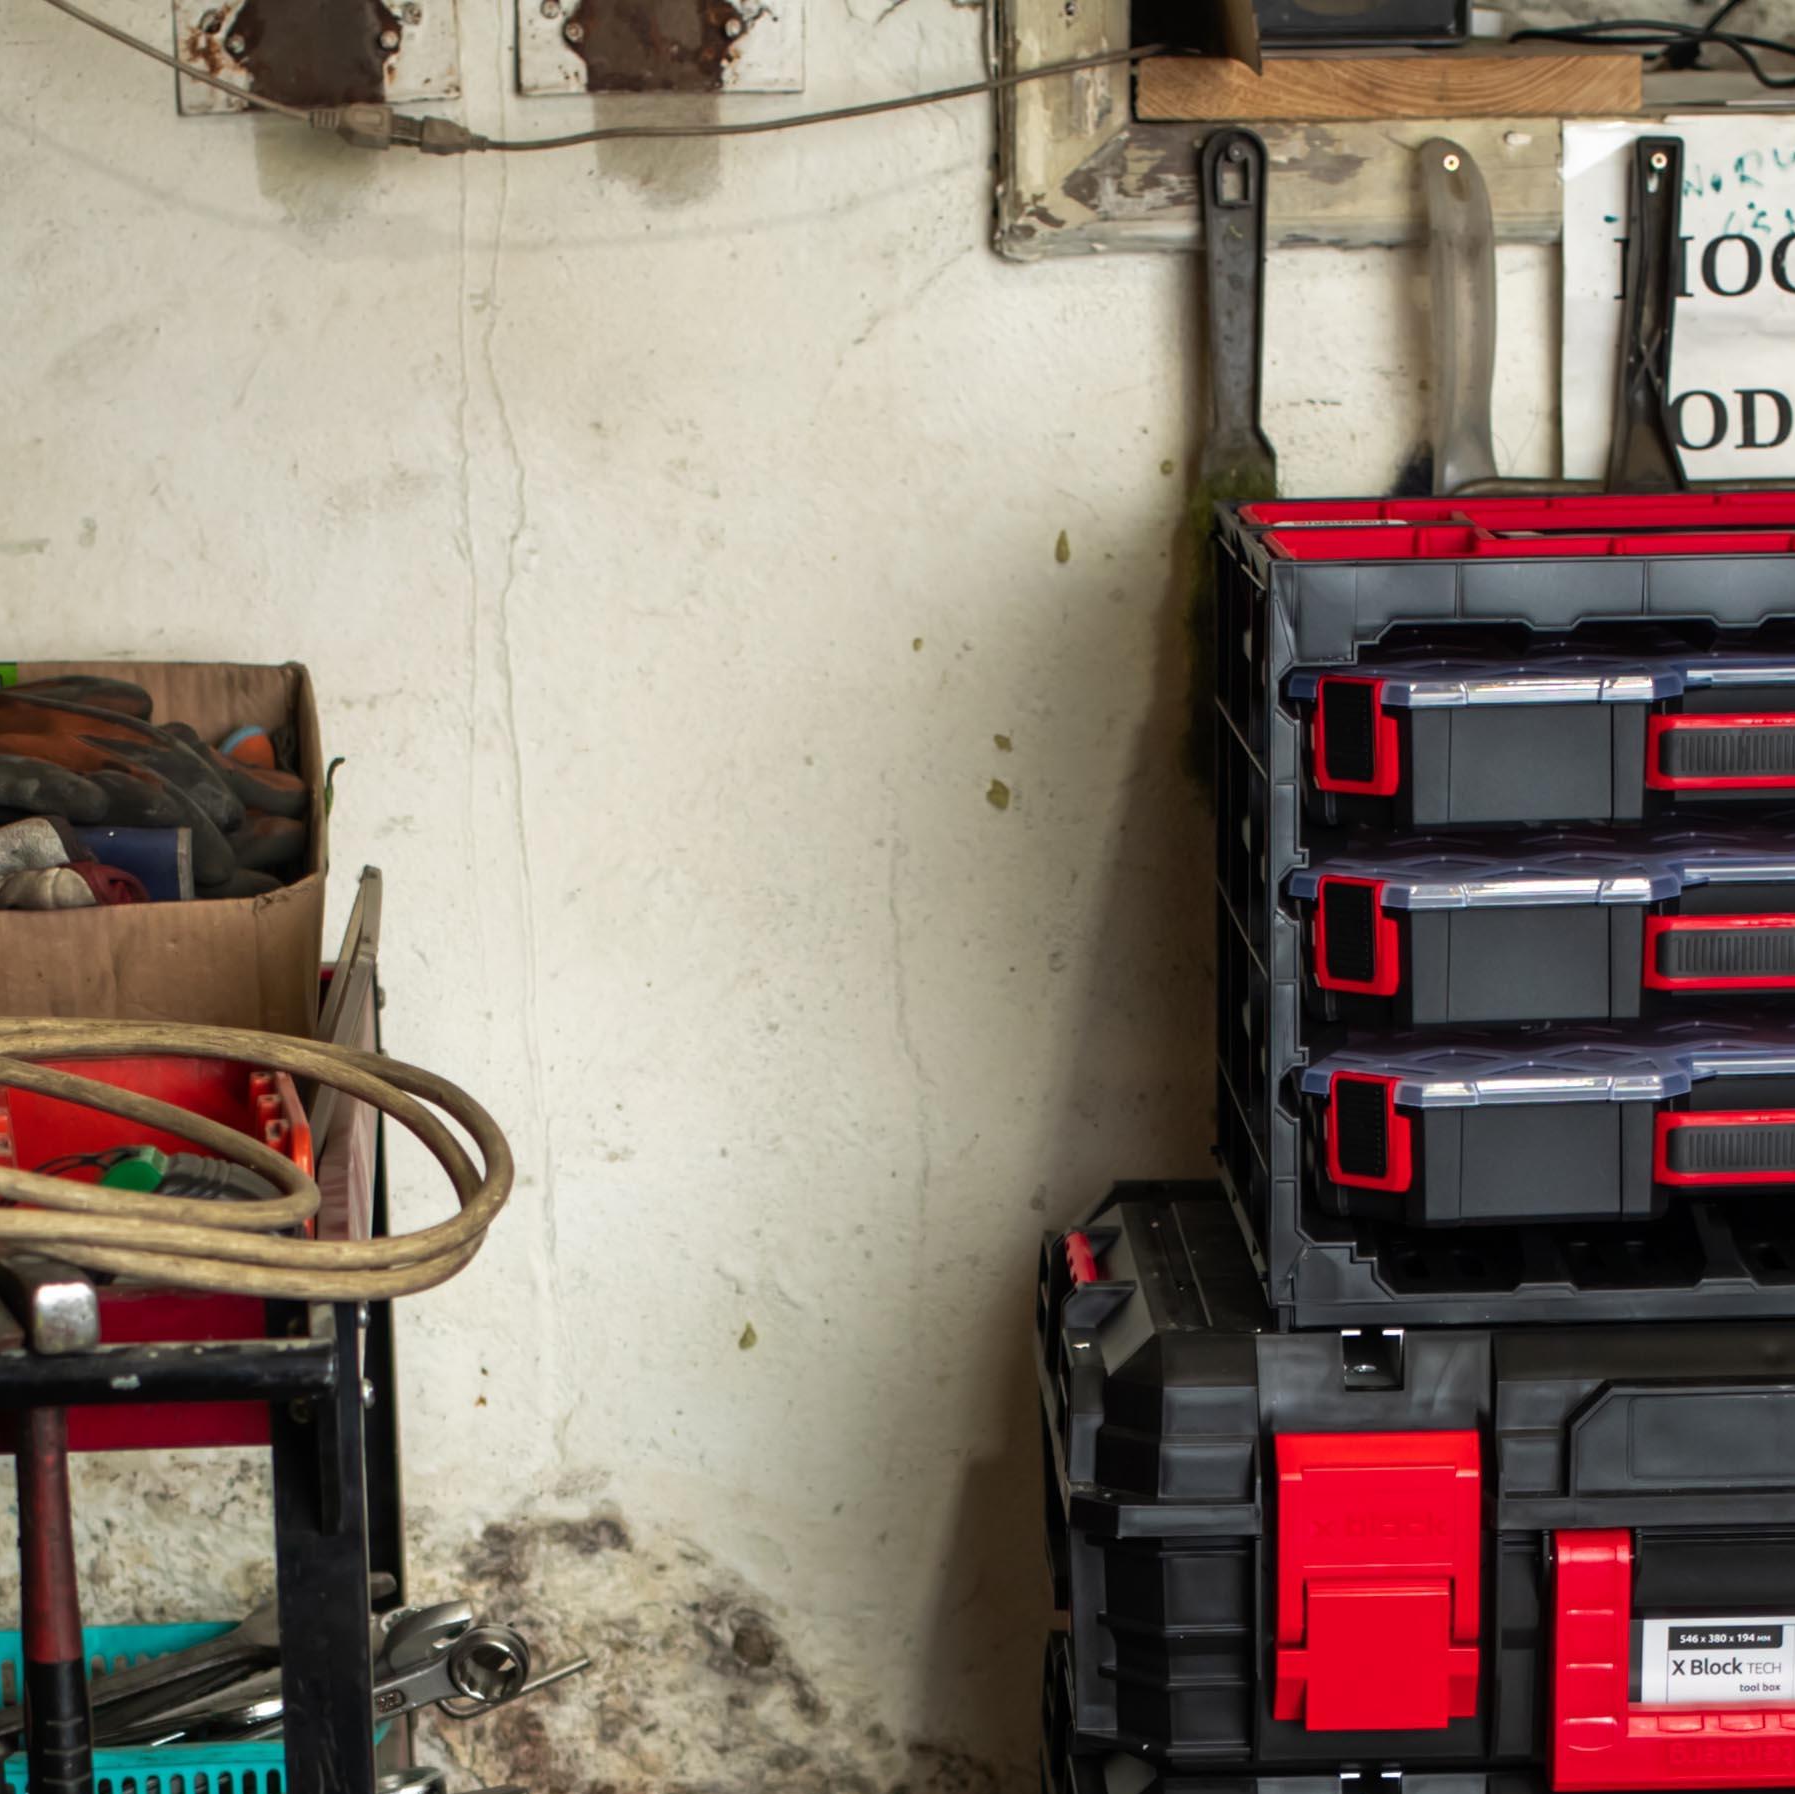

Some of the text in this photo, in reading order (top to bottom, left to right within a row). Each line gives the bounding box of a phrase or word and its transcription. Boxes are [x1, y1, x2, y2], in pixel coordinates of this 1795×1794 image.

[1679, 1633, 1698, 1644] 546
[1708, 1633, 1727, 1643] 380
[1736, 1632, 1755, 1643] 194
[1672, 1659, 1686, 1675] X
[1690, 1656, 1743, 1676] Block
[1746, 1661, 1782, 1675] TECH
[1739, 1681, 1782, 1693] tool box
